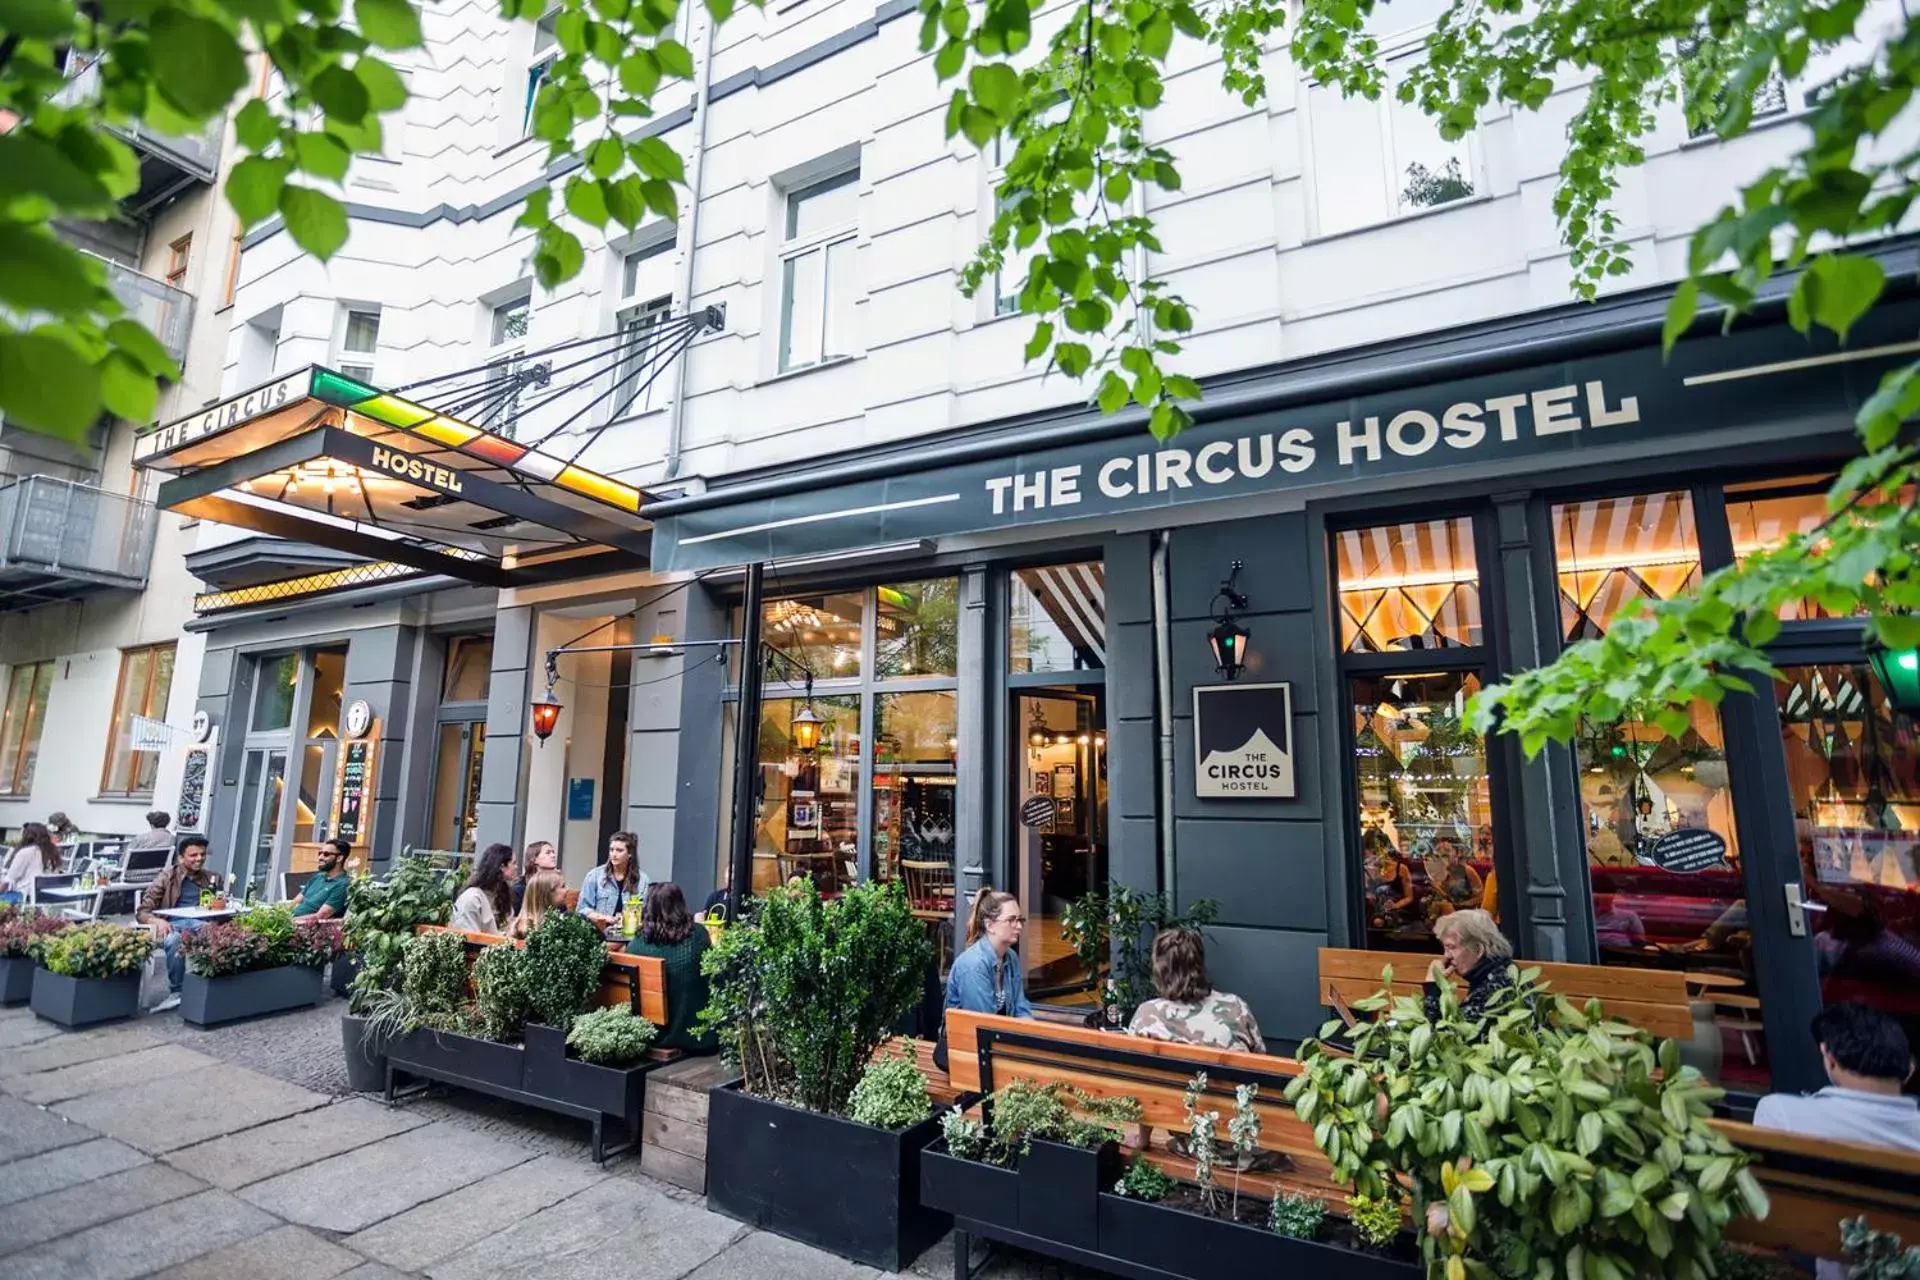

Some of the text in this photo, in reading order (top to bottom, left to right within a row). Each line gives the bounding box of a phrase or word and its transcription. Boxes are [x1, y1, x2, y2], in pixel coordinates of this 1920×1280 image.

[154, 383, 288, 451] THE CIRCUS
[985, 380, 1640, 514] THE CIRCUS HOSTEL
[371, 446, 463, 493] HOSTEL
[1208, 764, 1281, 778] CIRCUS
[1245, 753, 1267, 762] THE
[1221, 781, 1269, 791] HOSTEL
